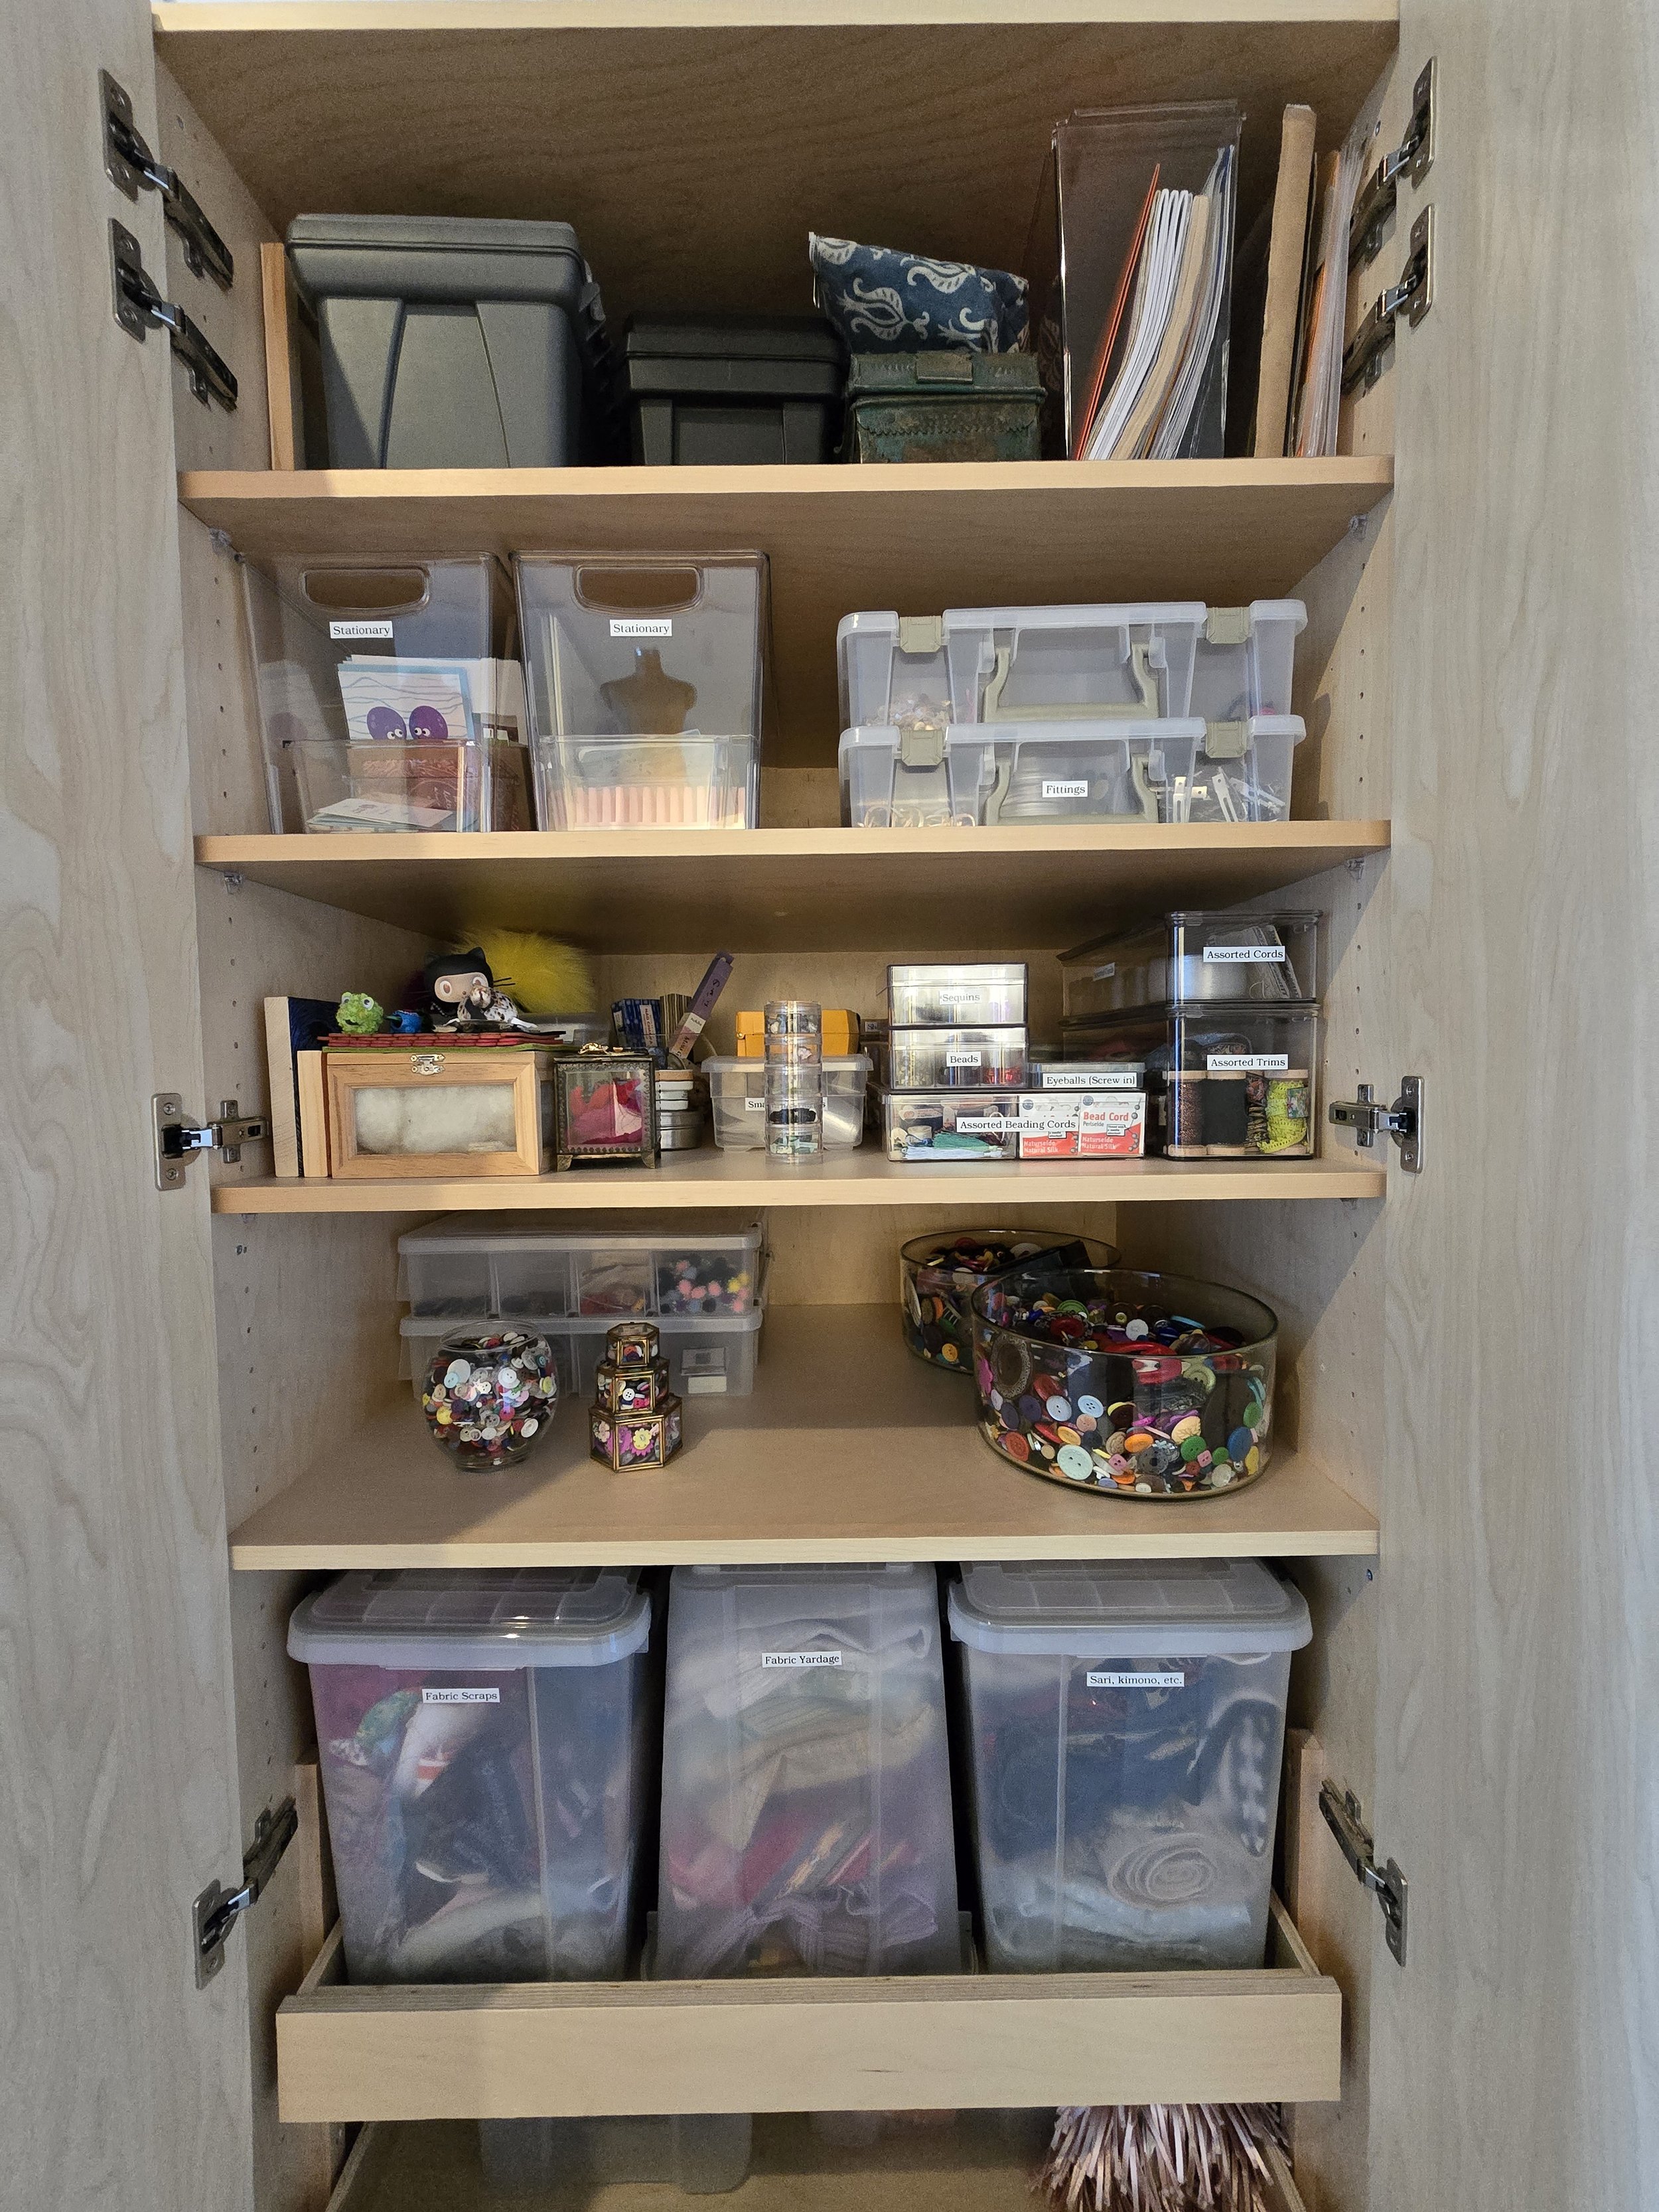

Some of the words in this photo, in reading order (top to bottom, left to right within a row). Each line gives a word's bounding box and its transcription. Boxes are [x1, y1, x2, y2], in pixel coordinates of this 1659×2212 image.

[333, 625, 390, 636] Stationary
[614, 624, 670, 634] Stationary
[1046, 785, 1086, 796] Fittings
[1207, 950, 1250, 959] Assorted
[1254, 950, 1283, 958] Cords
[942, 994, 980, 1003] Sequins
[1046, 1076, 1086, 1086] Eyeballs
[1088, 1076, 1120, 1086] (Screw
[1123, 1076, 1135, 1085] in)
[1083, 1112, 1106, 1121] Bead
[1109, 1112, 1129, 1122] Cord
[1005, 1120, 1045, 1130] Beading
[1047, 1120, 1076, 1128] Cords
[765, 1656, 797, 1664] Fabric
[799, 1655, 839, 1664] Yardage
[1090, 1676, 1115, 1684] Sari,
[1118, 1676, 1160, 1684] kimono,
[425, 1692, 459, 1700] Fabric
[461, 1692, 497, 1701] Scraps
